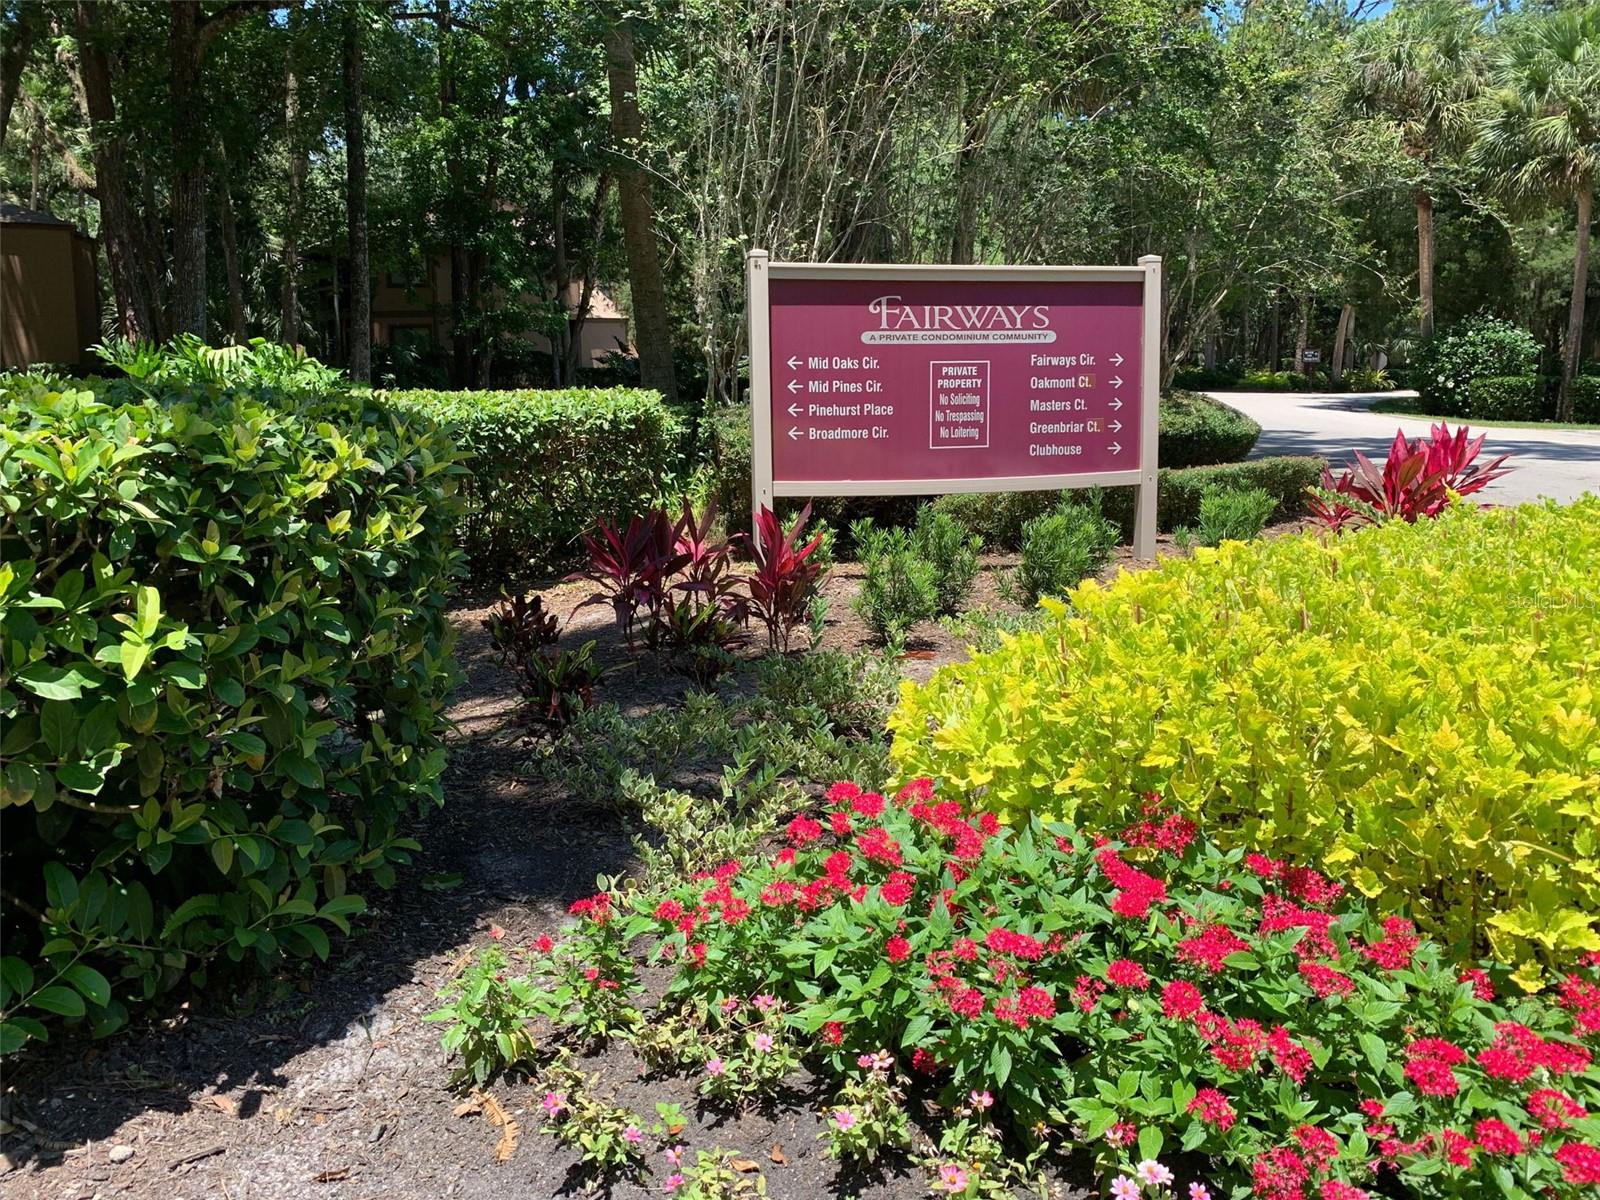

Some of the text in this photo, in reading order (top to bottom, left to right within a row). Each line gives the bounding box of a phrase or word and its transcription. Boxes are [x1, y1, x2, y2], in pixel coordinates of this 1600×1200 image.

[869, 296, 1050, 329] FAIRWAYS
[809, 357, 880, 369] Mid Oaks Cir.
[1031, 354, 1096, 368] Fairways Cir.
[942, 366, 978, 376] PRIVATE
[809, 380, 883, 392] Mid Pines Cir.
[938, 379, 982, 388] PROPERTY
[1031, 376, 1092, 389] Oakmont Ct.
[940, 393, 980, 407] No Soliciting
[1030, 399, 1088, 411] Masters Ct.
[809, 403, 893, 416] Pinehurst Place
[935, 409, 984, 423] No Trespassing
[809, 426, 889, 439] Broadmore Cir.
[940, 426, 979, 439] No Loitering
[1030, 421, 1101, 433] Greenbriar Ct.
[1030, 444, 1081, 456] Clubhouse
